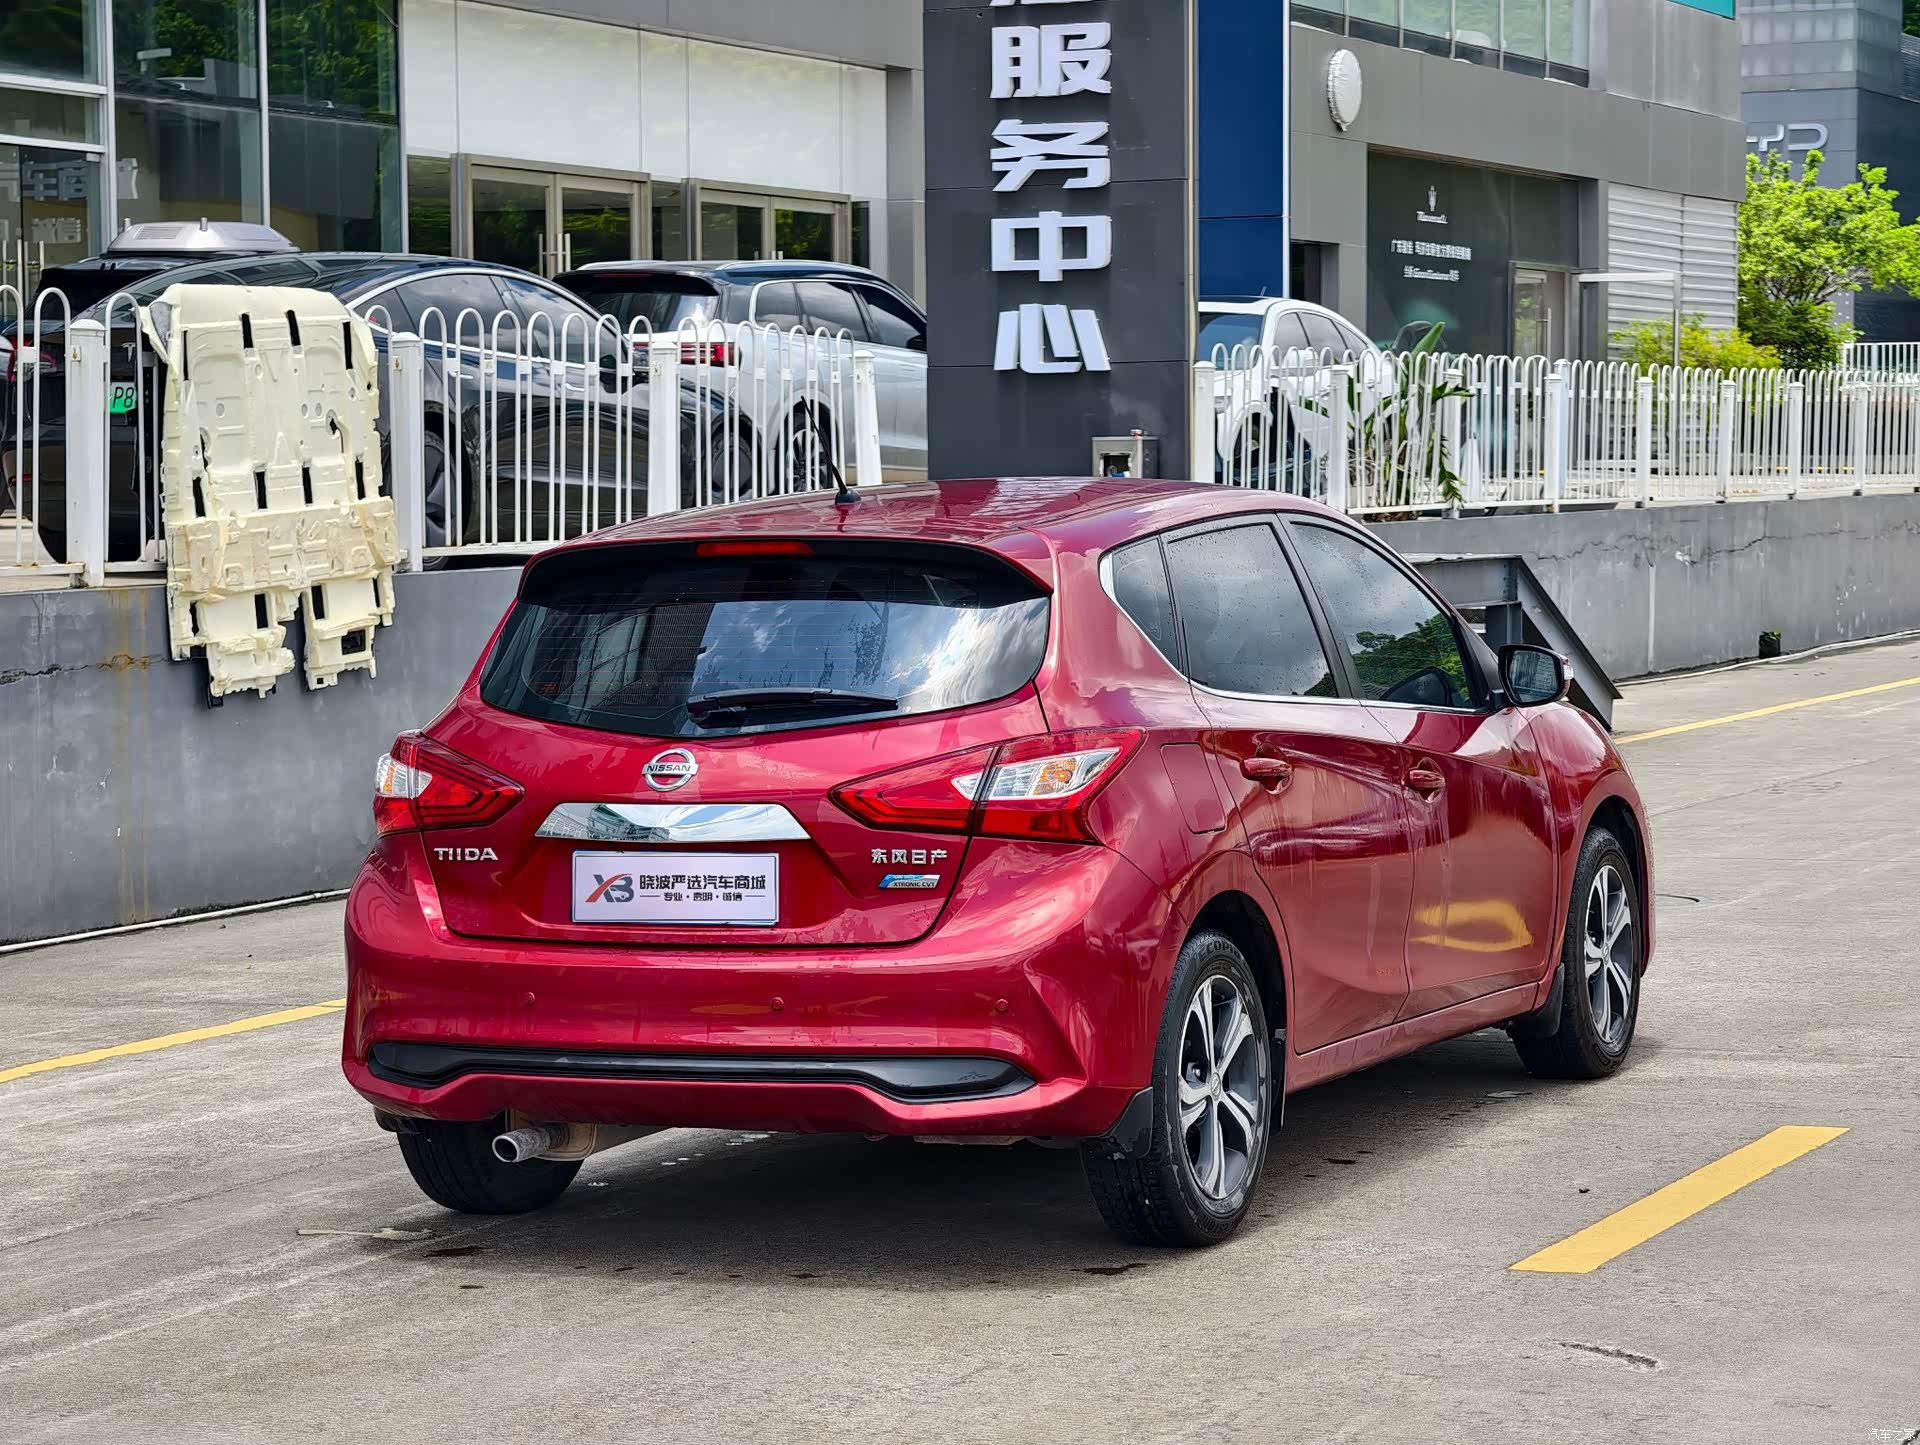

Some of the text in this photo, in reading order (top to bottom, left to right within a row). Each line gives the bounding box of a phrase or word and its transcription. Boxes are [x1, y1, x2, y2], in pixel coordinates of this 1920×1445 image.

[990, 0, 1112, 374] 服务中心
[646, 763, 691, 772] NISSAN
[433, 847, 499, 861] TIIDA
[871, 848, 948, 865] 东风日产
[639, 874, 766, 890] 晓波严选汽车商城
